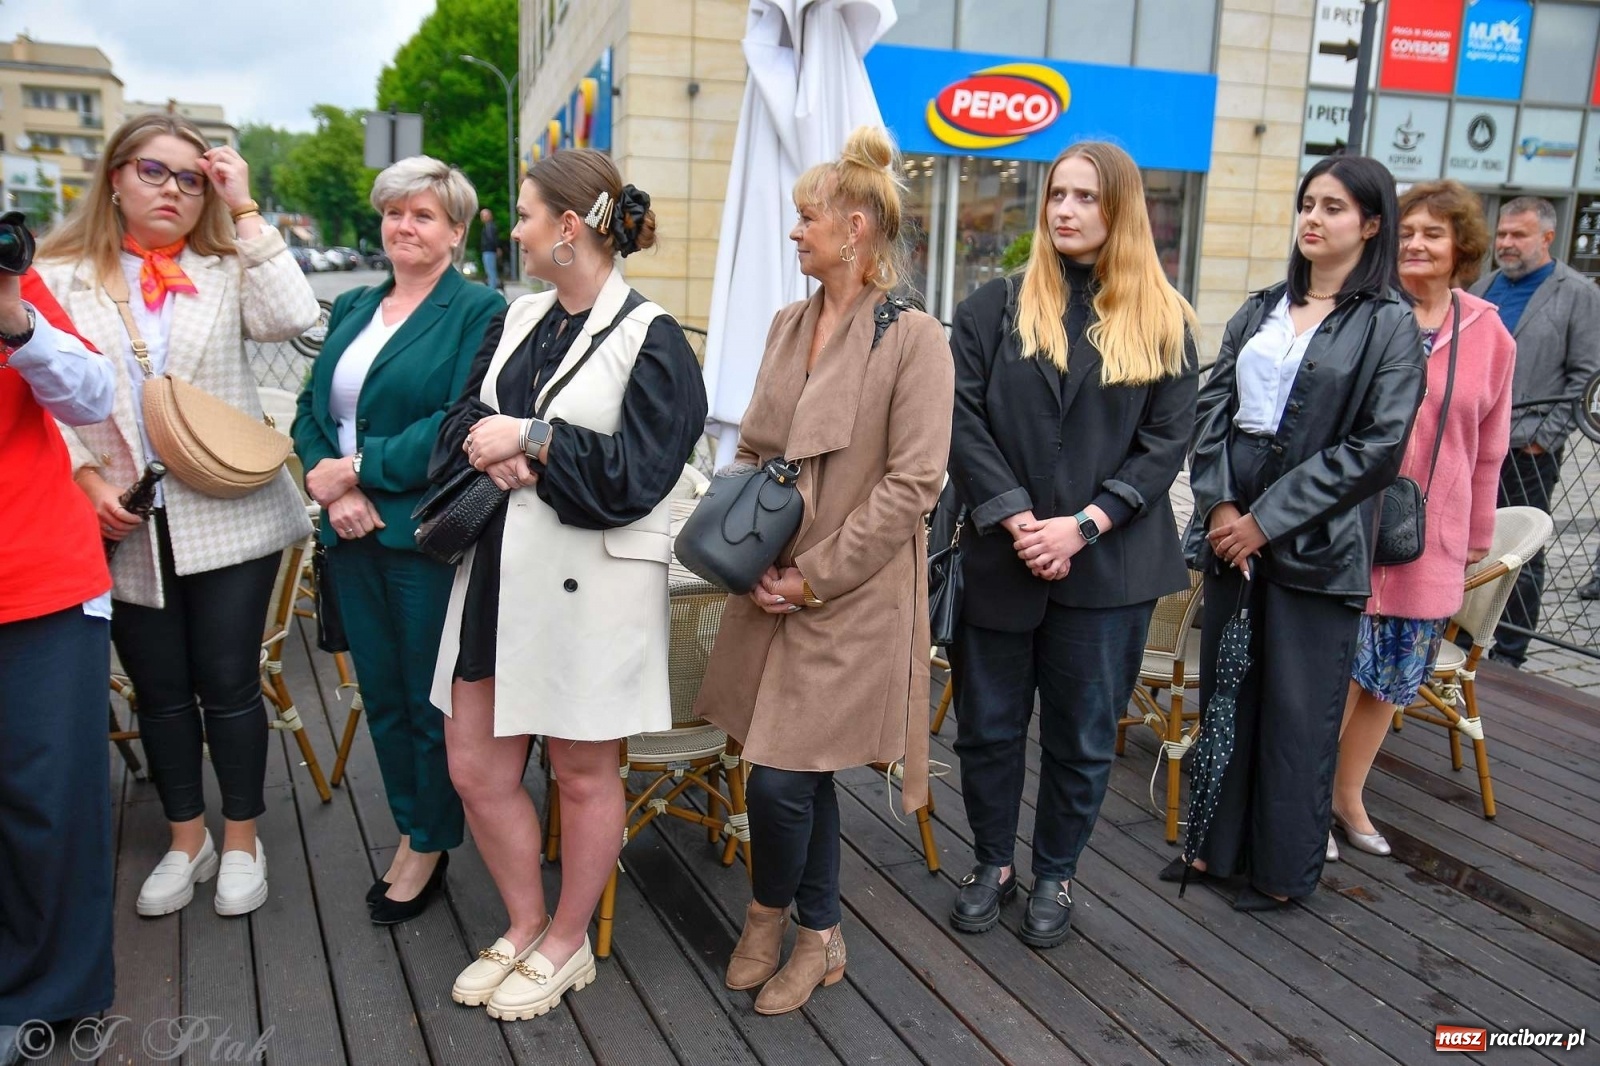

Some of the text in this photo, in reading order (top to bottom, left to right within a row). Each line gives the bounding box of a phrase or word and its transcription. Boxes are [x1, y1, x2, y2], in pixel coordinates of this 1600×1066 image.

[1333, 7, 1372, 26] PIĘT
[951, 88, 1050, 124] PEPCO
[1317, 106, 1362, 125] PIĘT
